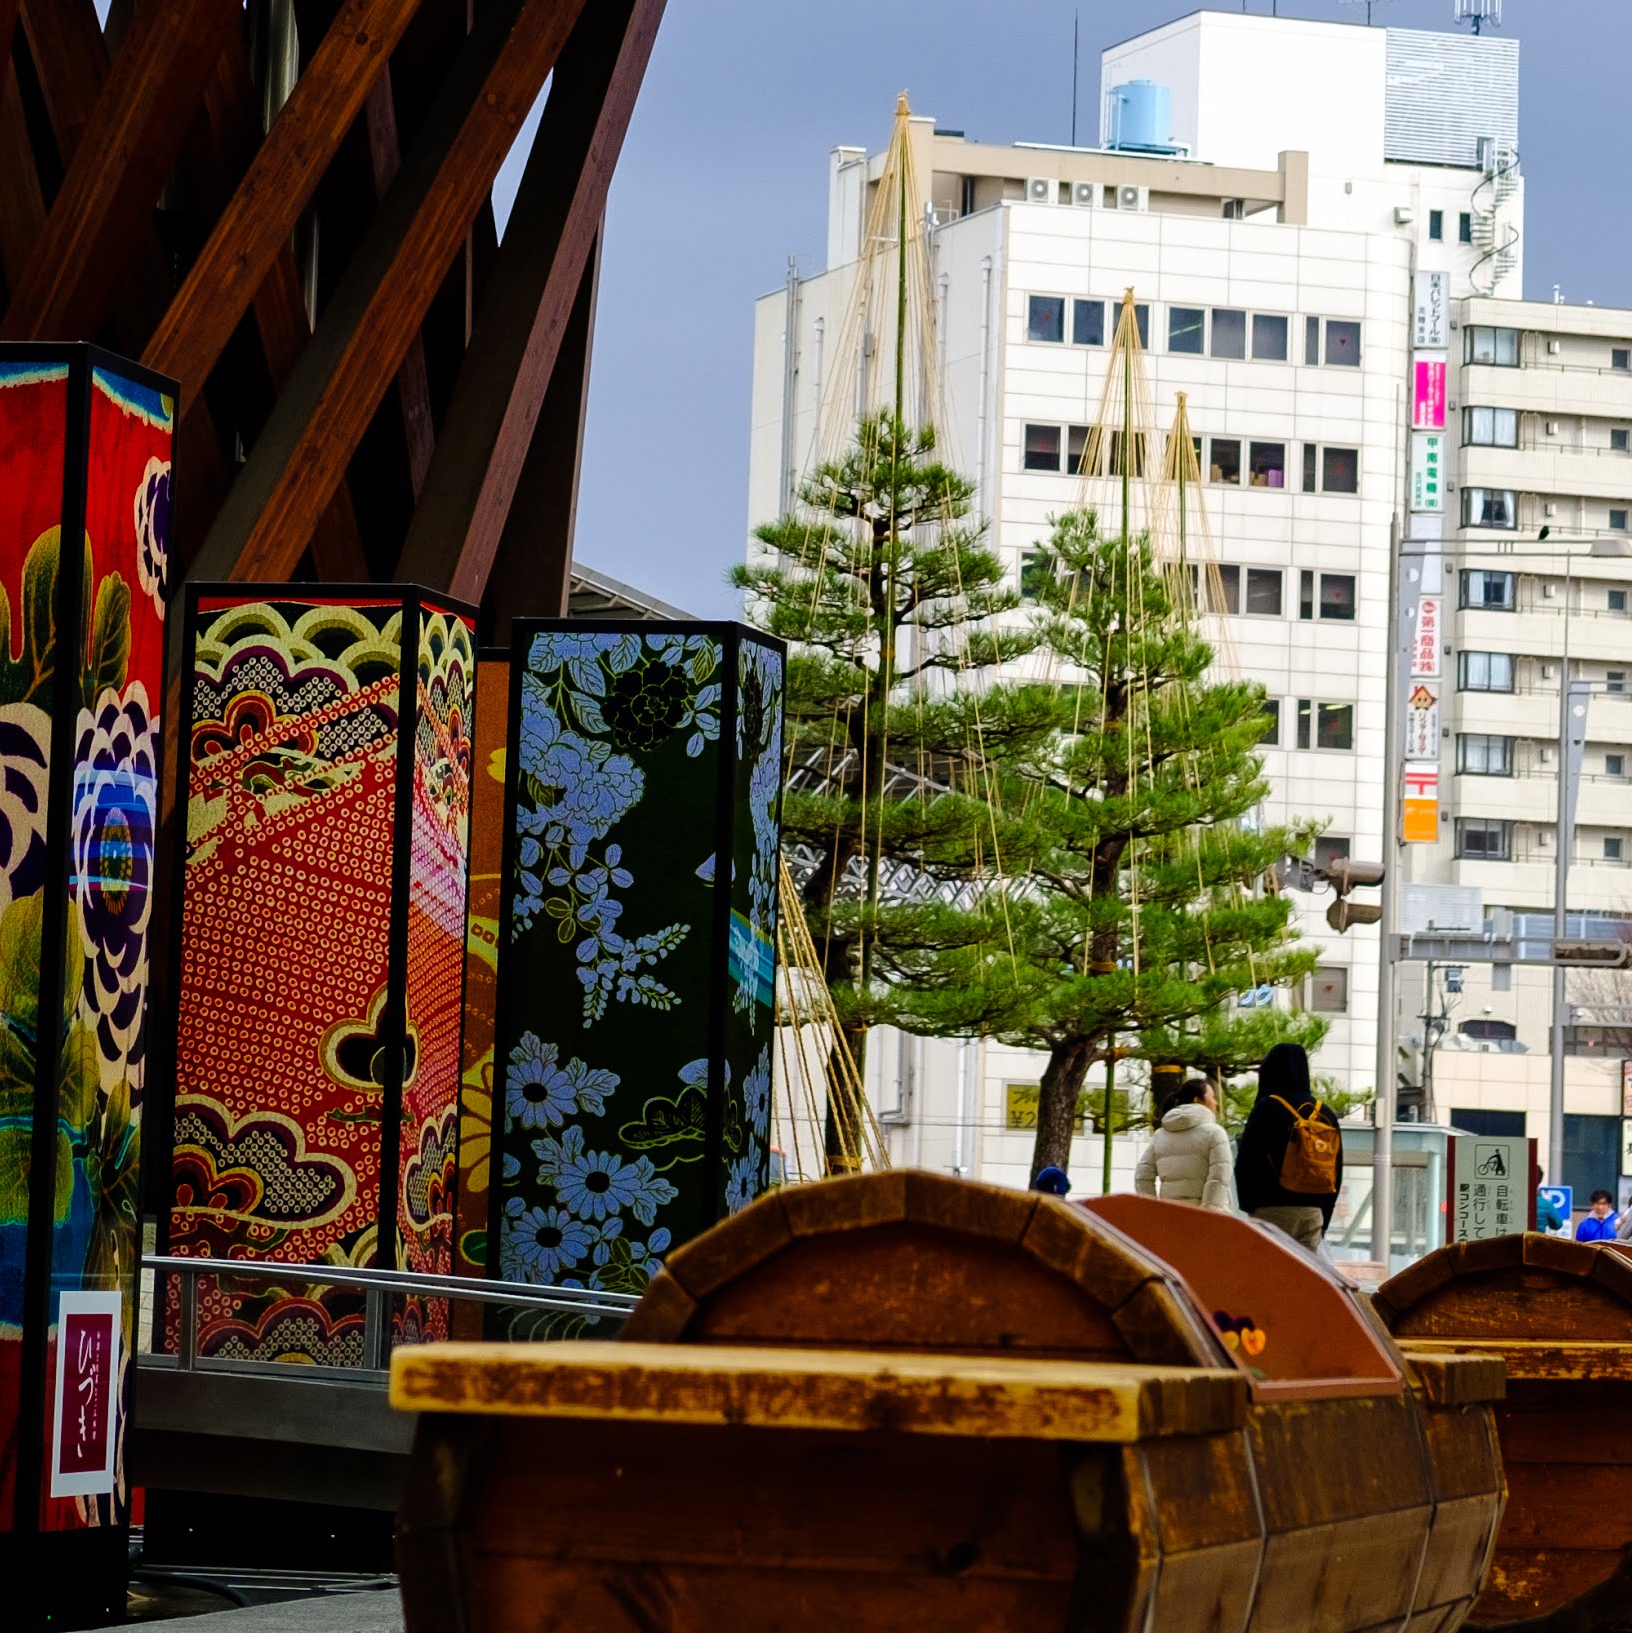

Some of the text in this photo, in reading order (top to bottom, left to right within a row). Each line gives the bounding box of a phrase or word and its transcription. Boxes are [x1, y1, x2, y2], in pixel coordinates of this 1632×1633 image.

[1473, 1183, 1486, 1238] 通行して
[1495, 1184, 1509, 1236] 自転車は
